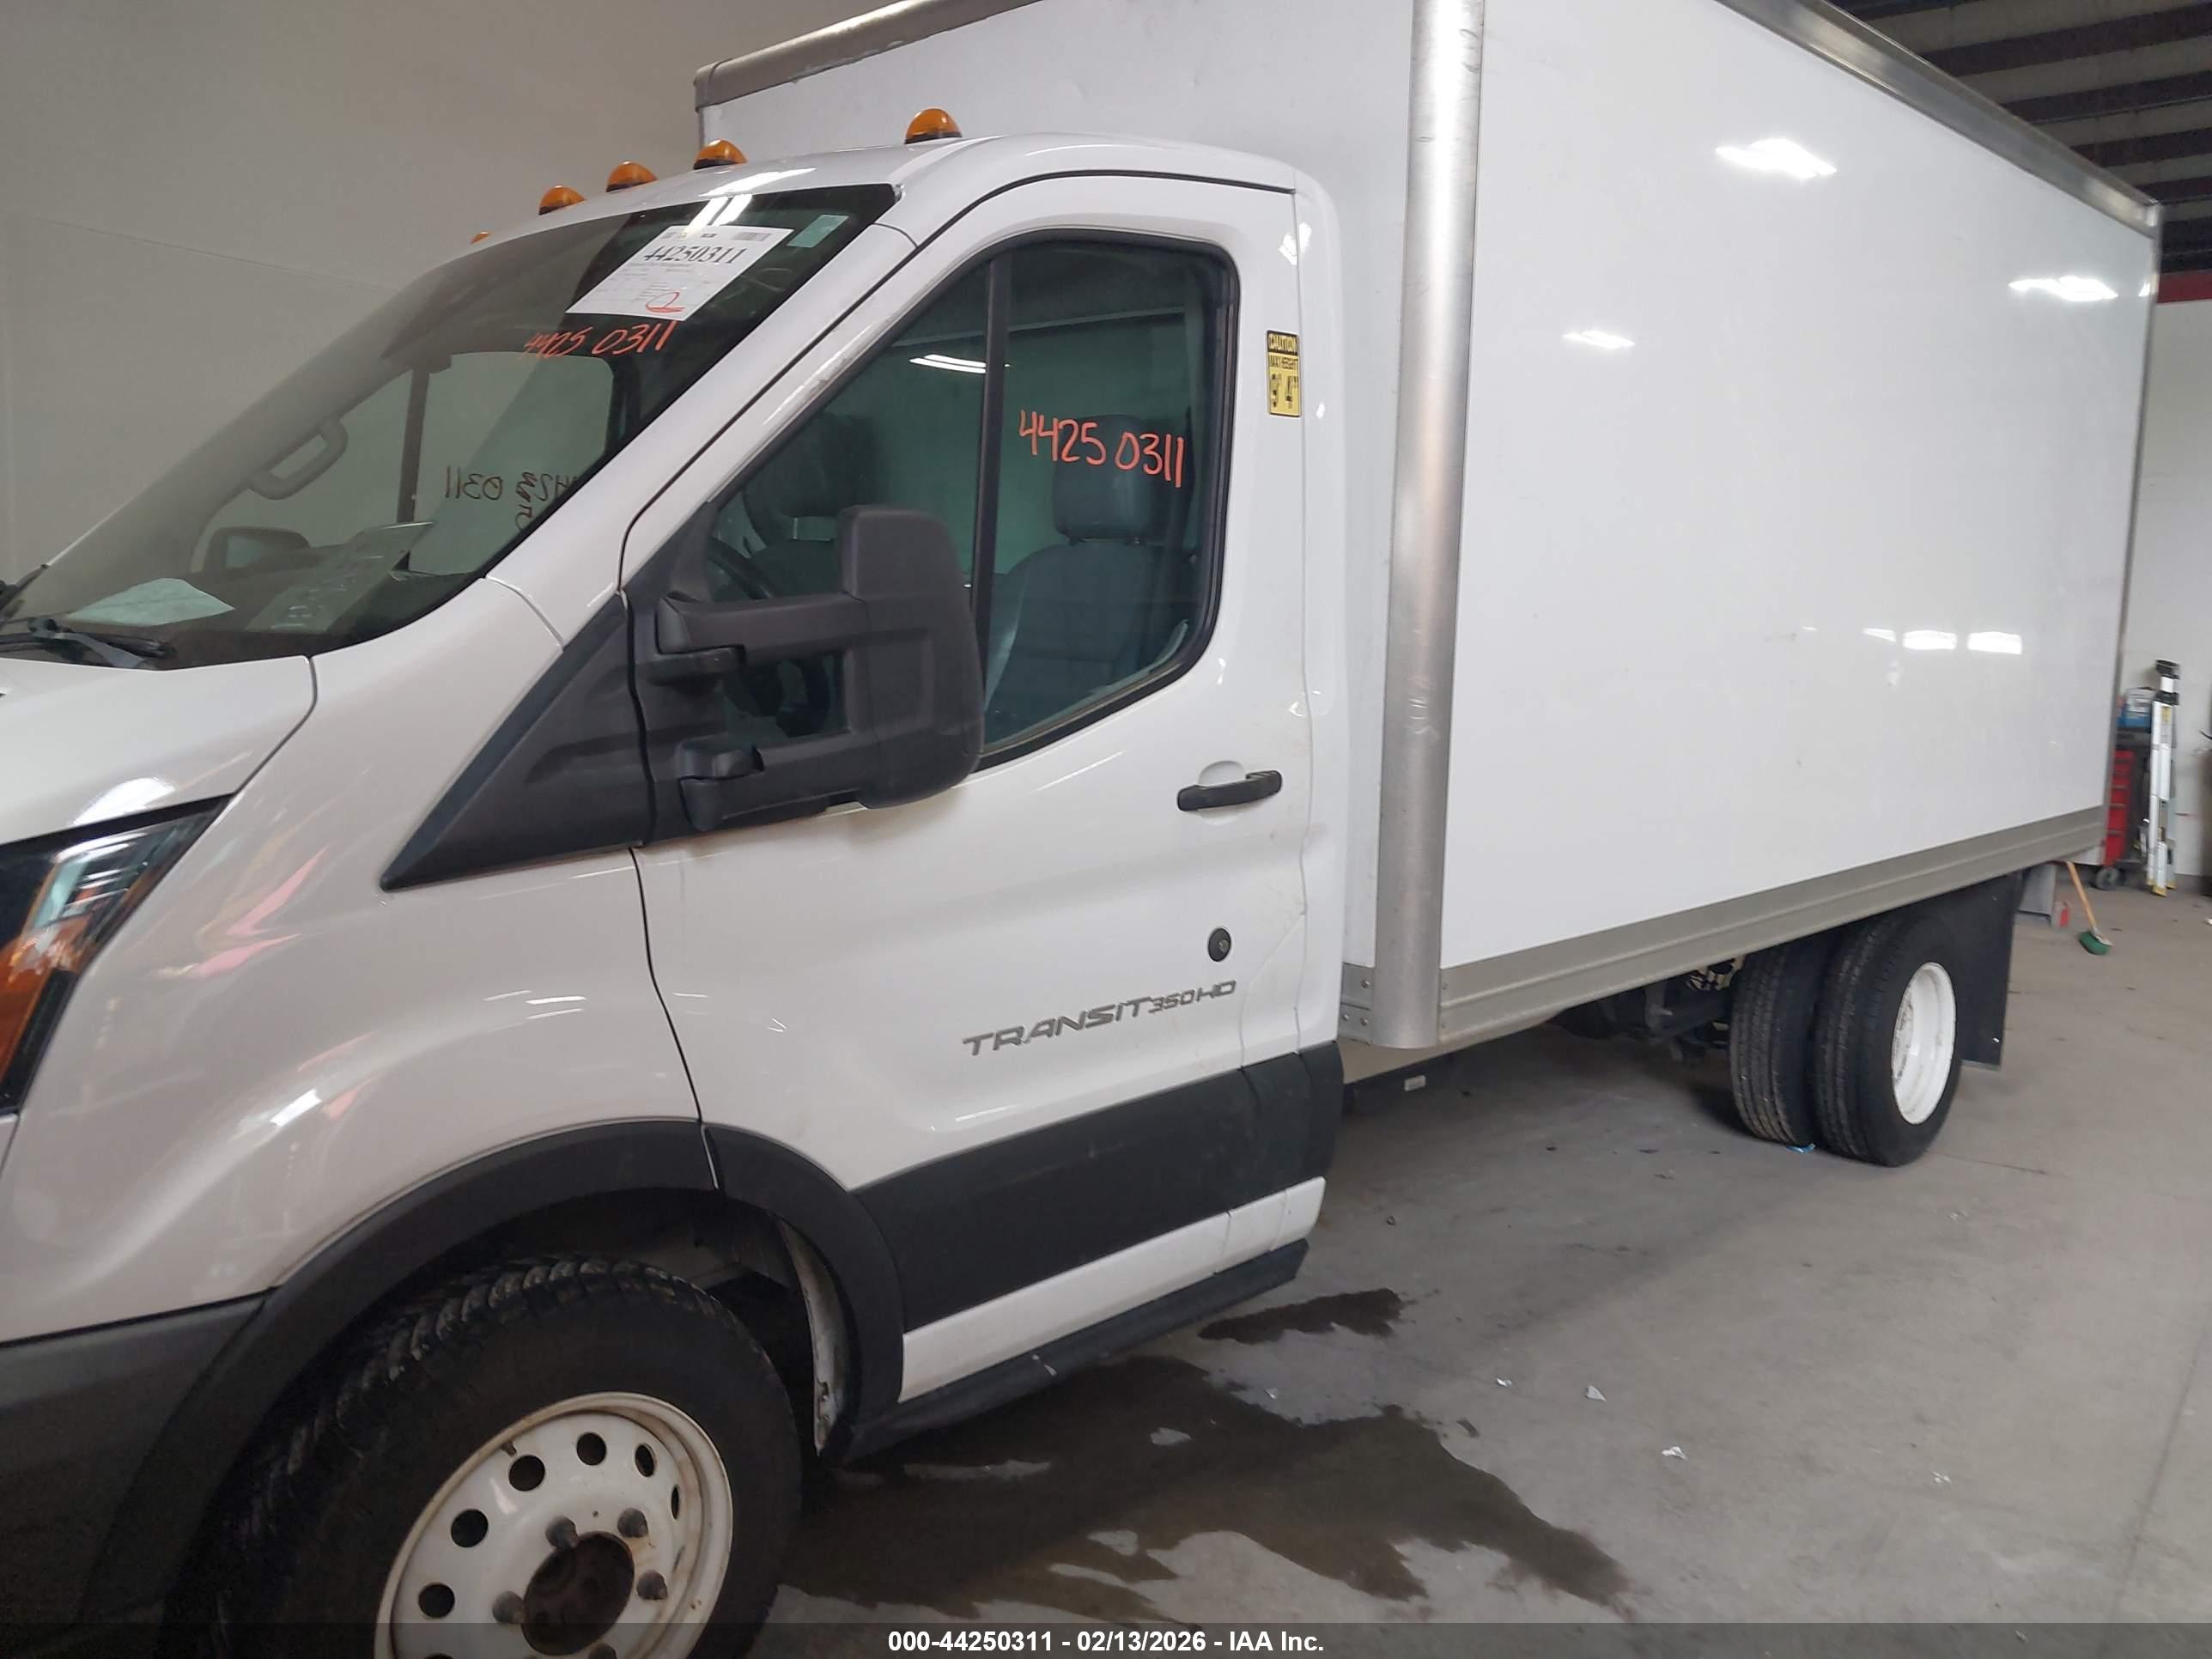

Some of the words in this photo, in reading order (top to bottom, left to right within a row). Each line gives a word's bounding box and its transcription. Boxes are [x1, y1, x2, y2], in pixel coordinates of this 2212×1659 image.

[644, 246, 747, 264] 44250311
[592, 320, 679, 354] 0311
[1018, 409, 1107, 465] 4425
[1114, 431, 1186, 489] 0311
[962, 996, 1152, 1056] TRANSIT
